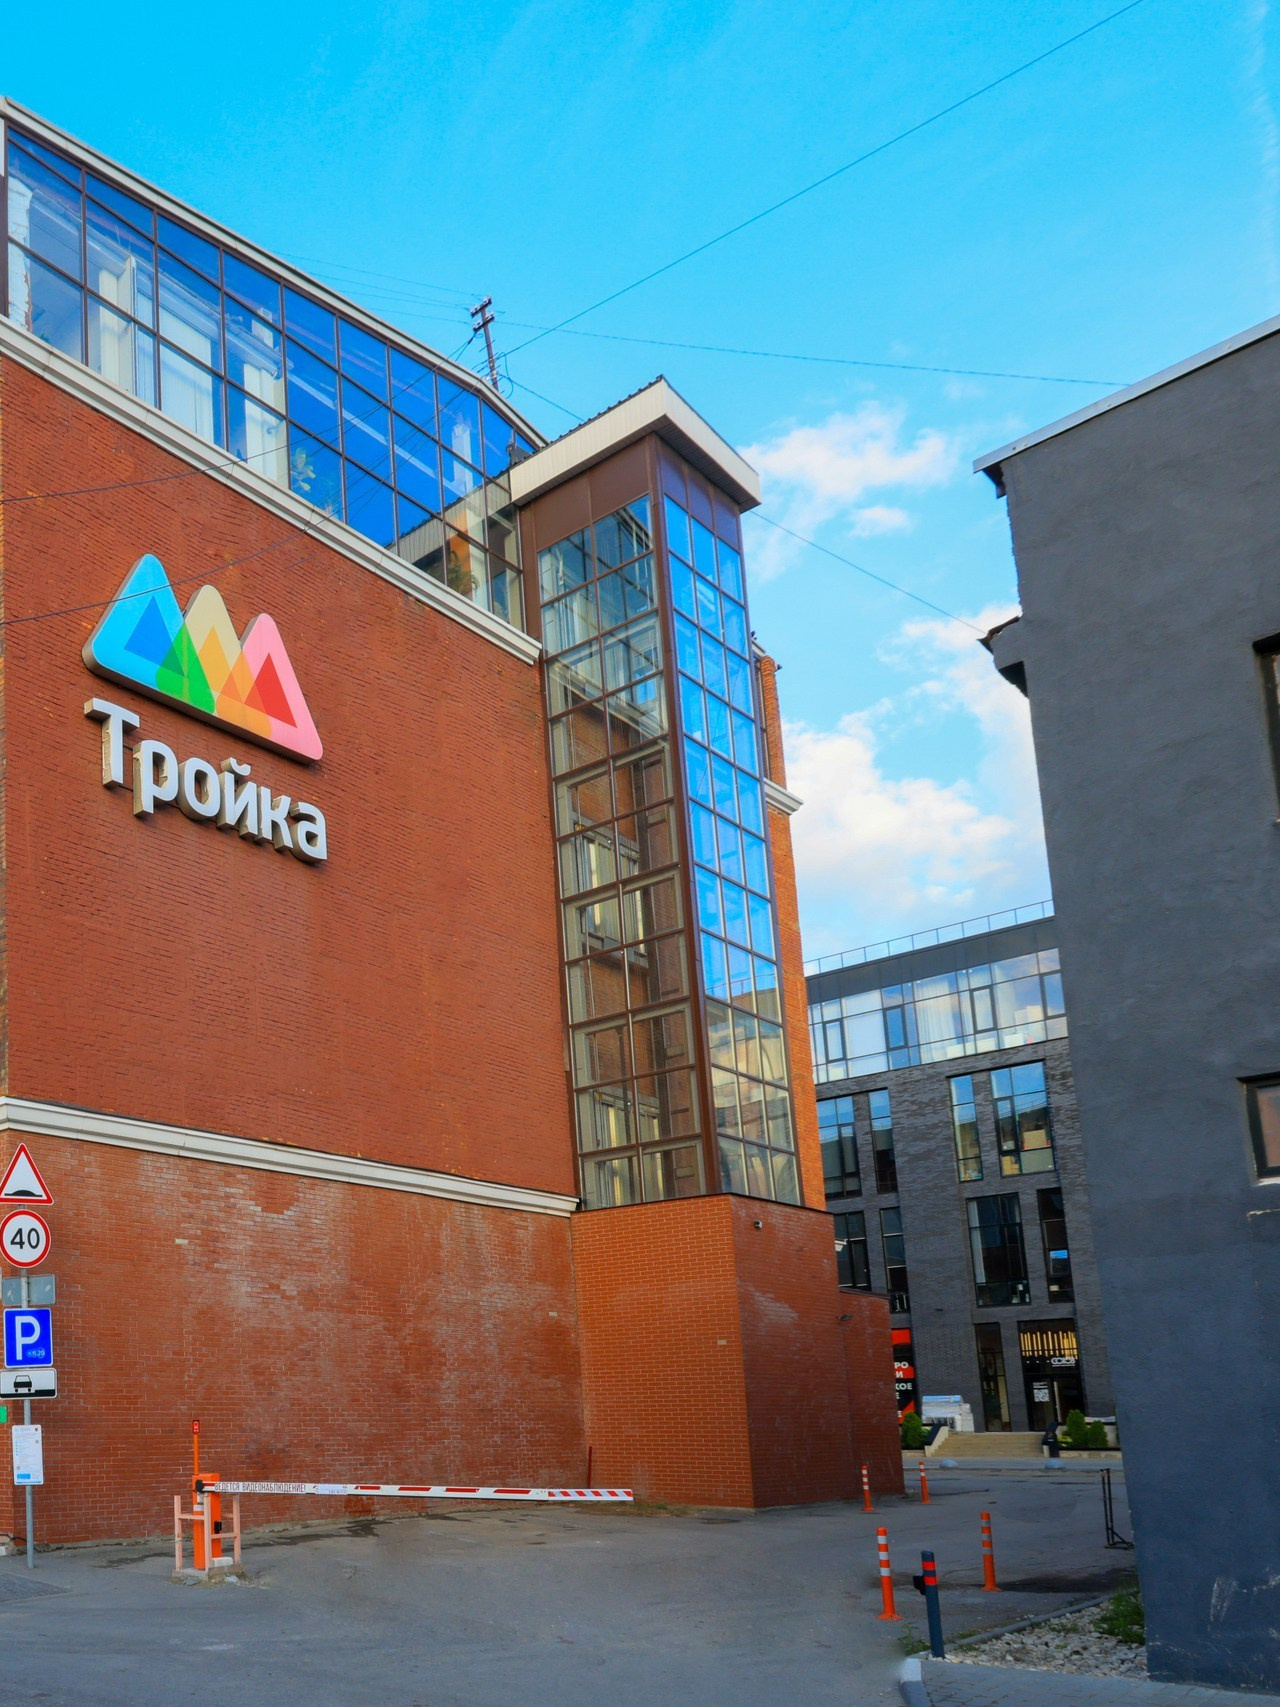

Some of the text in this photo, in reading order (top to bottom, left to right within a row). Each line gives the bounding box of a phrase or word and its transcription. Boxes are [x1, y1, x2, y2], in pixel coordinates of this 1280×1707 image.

[84, 697, 328, 862] Тройка
[10, 1228, 40, 1250] 40
[15, 1316, 41, 1360] P
[214, 1482, 306, 1493] ВЕДЕТСЯ ВИДЕОНАБЛЮДЕНИЕ!
